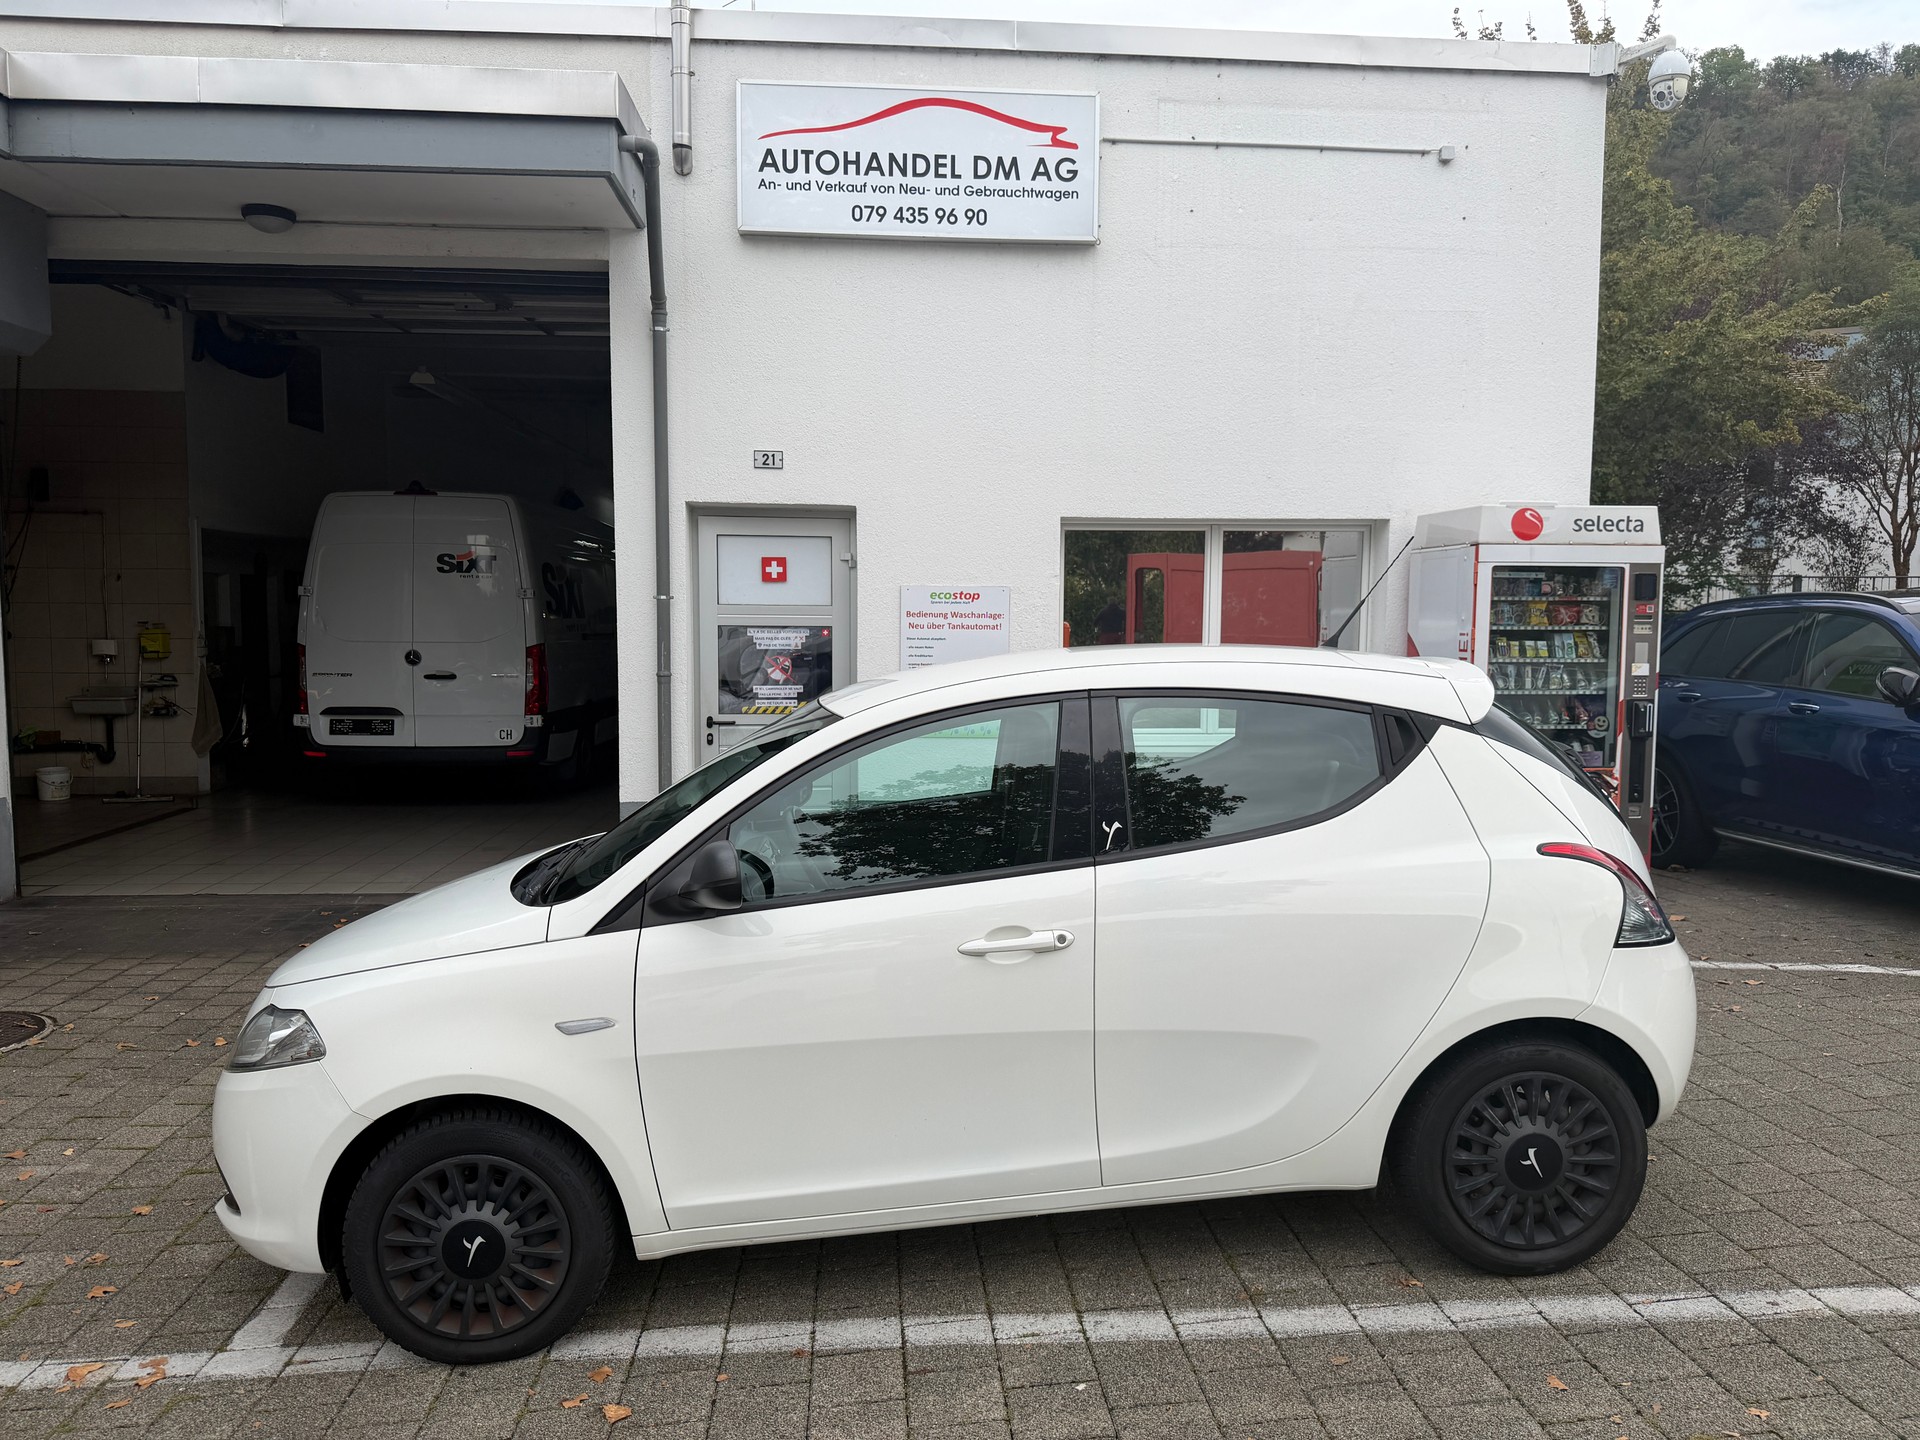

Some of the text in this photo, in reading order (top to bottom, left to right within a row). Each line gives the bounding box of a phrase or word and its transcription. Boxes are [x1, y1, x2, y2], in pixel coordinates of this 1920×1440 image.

[757, 148, 1079, 183] AUTOHANDEL DM AG
[757, 179, 1079, 202] An- und Verkauf von Neu- und Gebrauchtwagen
[851, 205, 988, 226] 079 435 96 90
[762, 453, 775, 466] 21
[1572, 515, 1644, 533] selecta
[930, 591, 980, 602] ecostop
[906, 611, 1005, 620] Bedienung Waschanlage:
[908, 622, 1002, 631] Neu über Tankautomat!
[499, 729, 513, 740] CH
